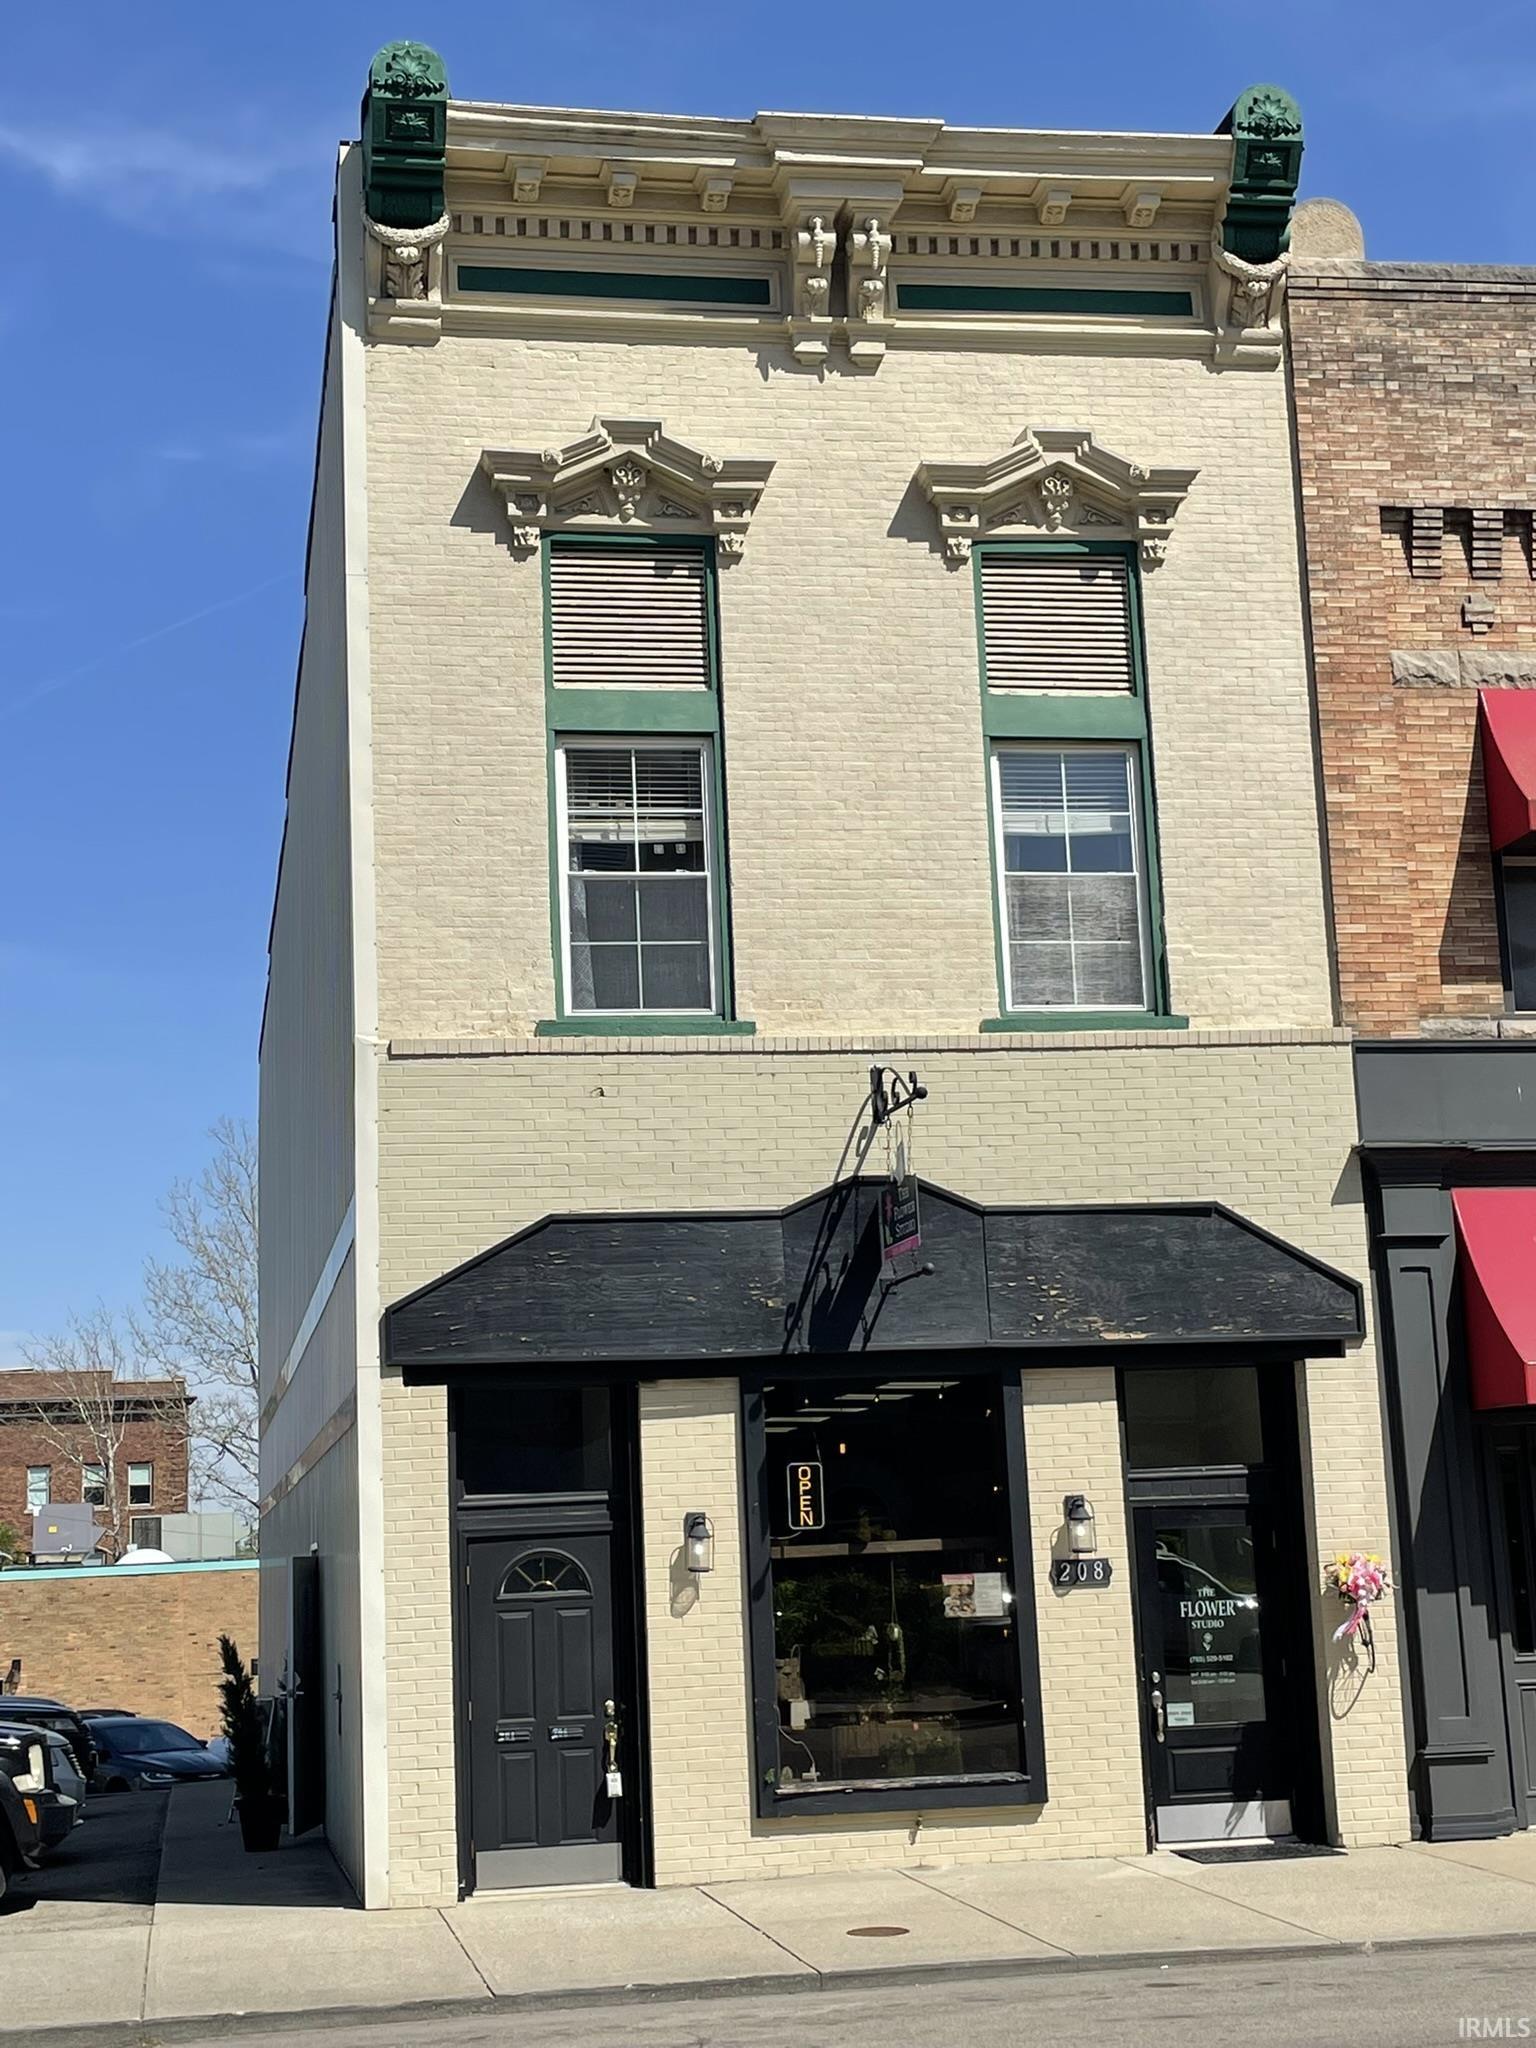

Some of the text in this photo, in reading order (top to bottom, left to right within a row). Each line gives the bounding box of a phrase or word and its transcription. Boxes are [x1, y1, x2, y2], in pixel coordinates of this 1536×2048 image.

[798, 1466, 814, 1526] OPEN
[1059, 1561, 1104, 1582] 208
[1197, 1586, 1216, 1598] THE
[1179, 1600, 1236, 1618] FLOWER
[1191, 1619, 1225, 1630] STUDIO
